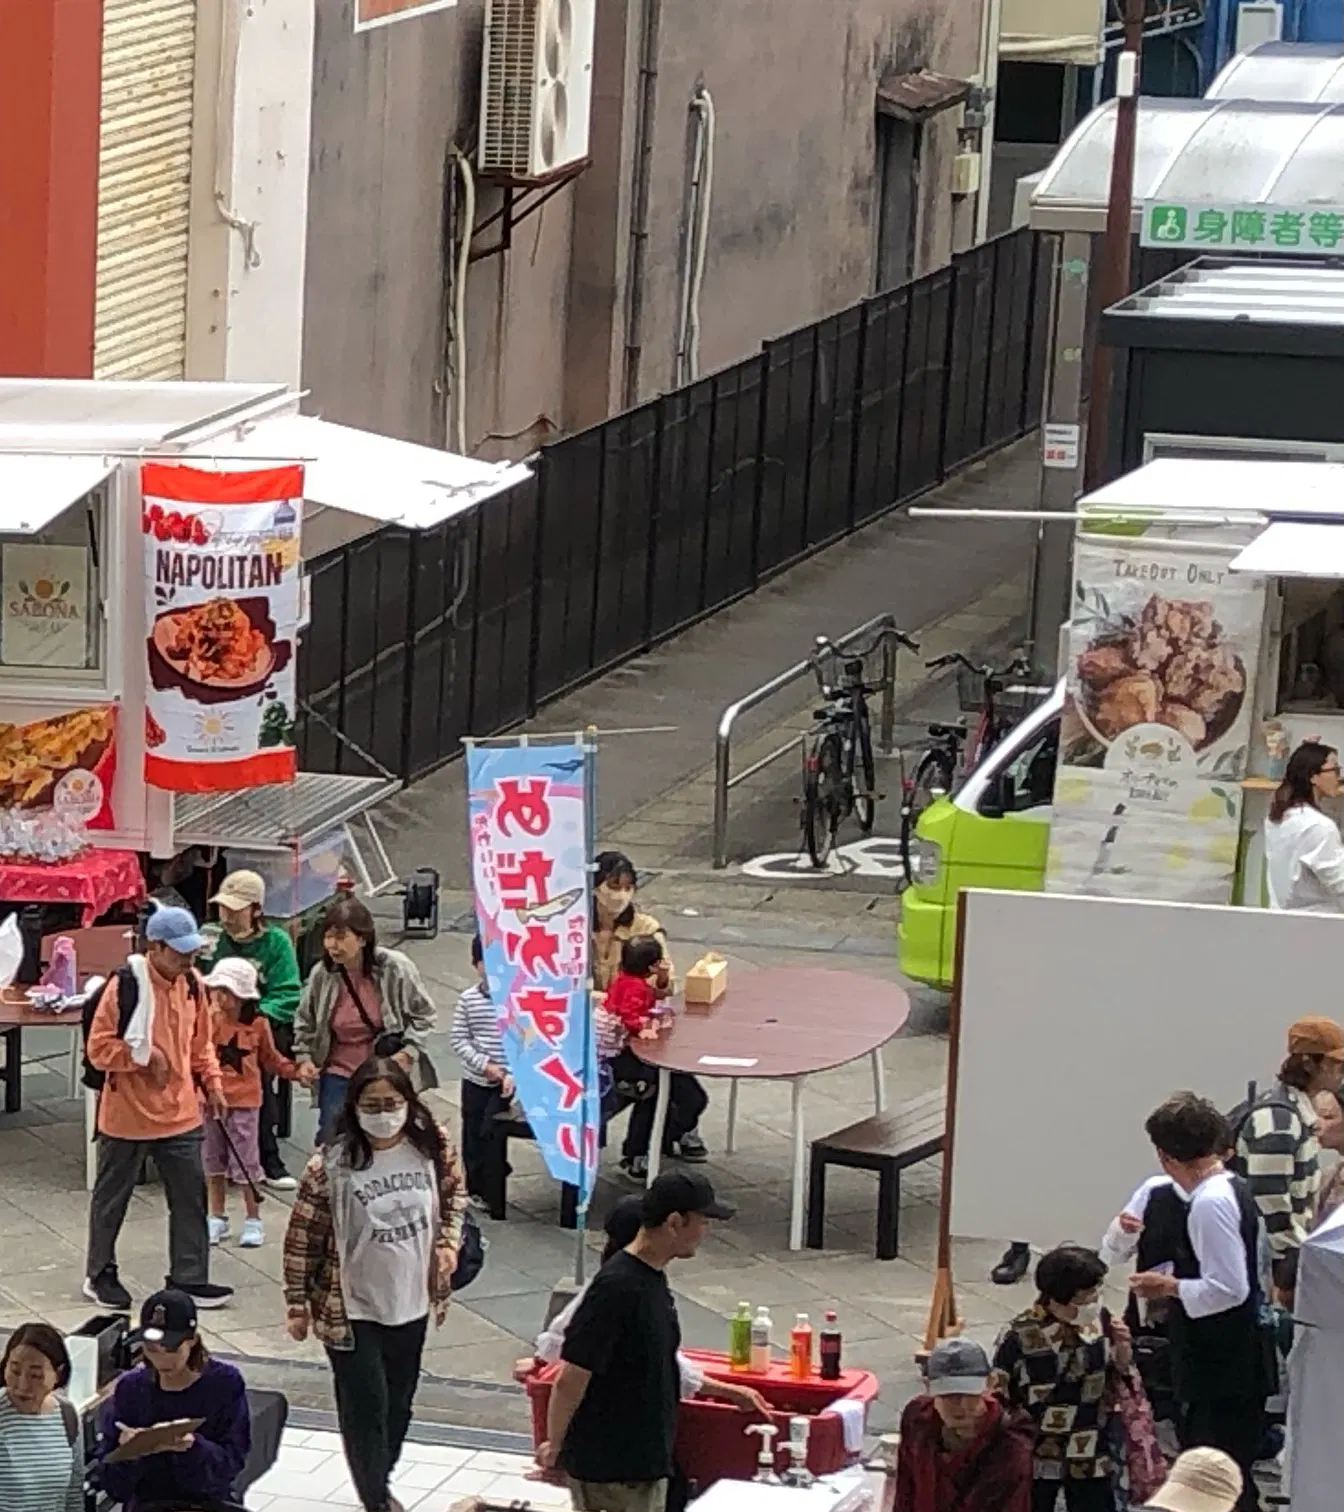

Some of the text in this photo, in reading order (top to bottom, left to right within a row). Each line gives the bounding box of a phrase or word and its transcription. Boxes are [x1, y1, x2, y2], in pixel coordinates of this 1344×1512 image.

[1194, 206, 1344, 248] 身障者等
[154, 548, 282, 590] NAPOLITAN
